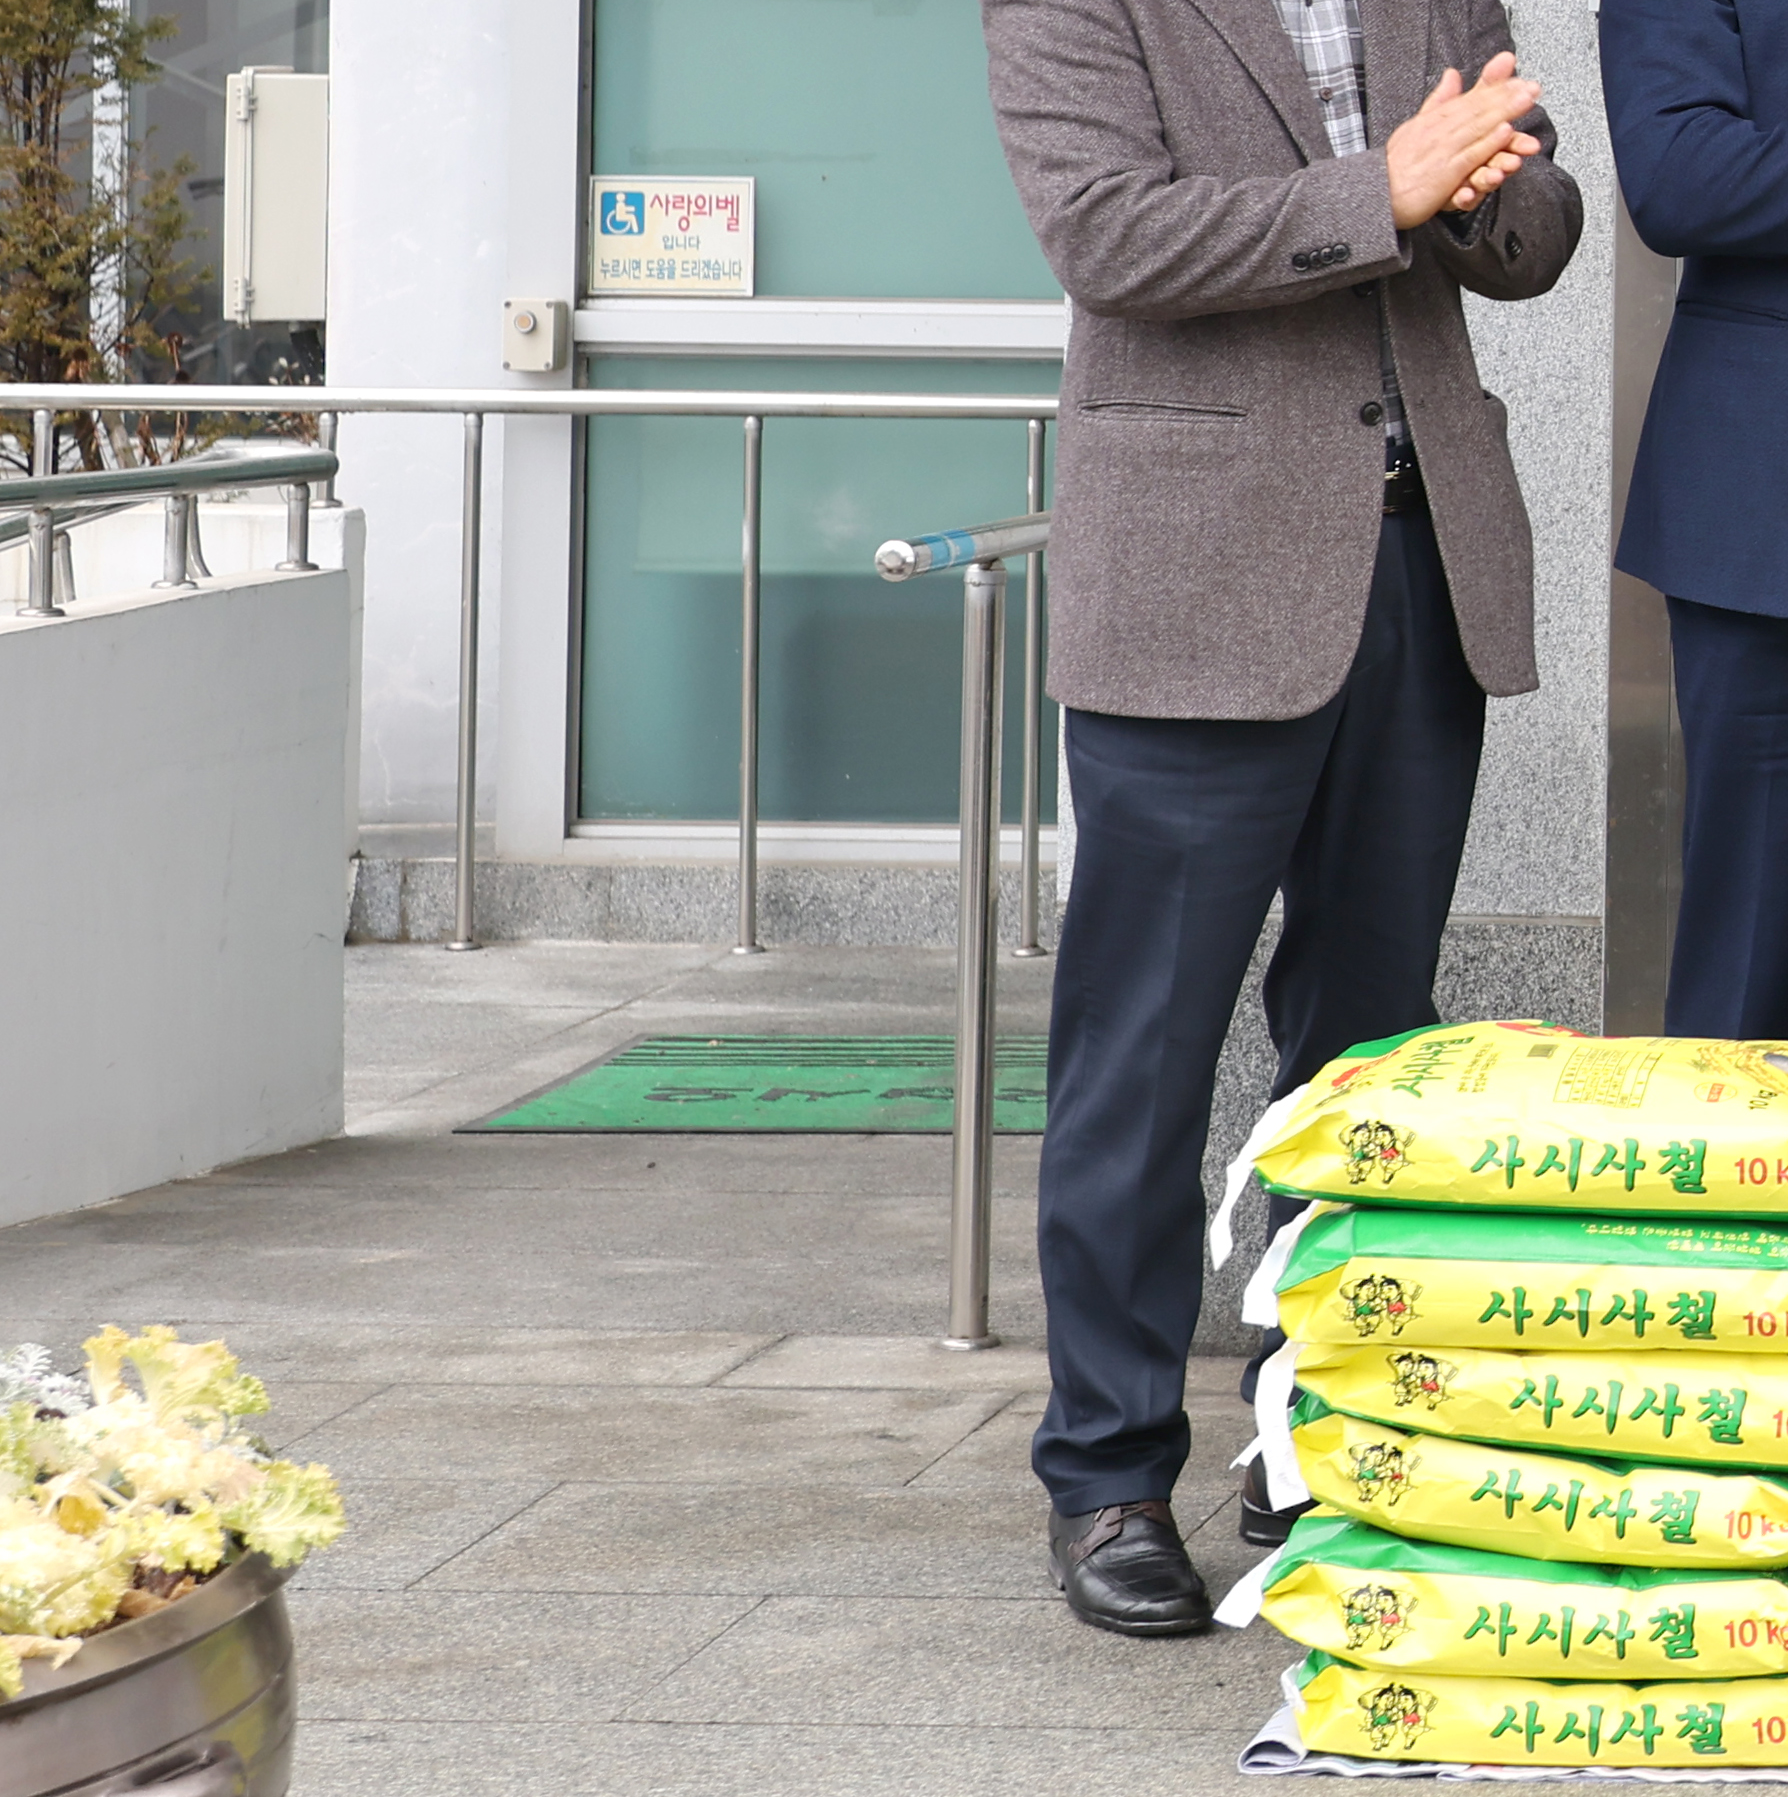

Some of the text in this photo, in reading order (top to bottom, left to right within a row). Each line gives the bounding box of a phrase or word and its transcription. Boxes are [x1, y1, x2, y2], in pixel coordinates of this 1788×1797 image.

[649, 193, 740, 233] 사랑의벨
[662, 235, 702, 250] 입니다
[1470, 1136, 1708, 1194] 사시사철
[1736, 1158, 1767, 1184] 10
[1478, 1287, 1717, 1340] 사시사철
[1745, 1312, 1776, 1336] 10
[1509, 1374, 1747, 1444] 사시사철
[1470, 1468, 1698, 1544] 사시사철
[1724, 1511, 1751, 1540] 10
[1464, 1603, 1699, 1660] 사시사철
[1726, 1620, 1757, 1647] 10
[1490, 1702, 1727, 1755] 사시사철
[1753, 1717, 1785, 1743] 10
